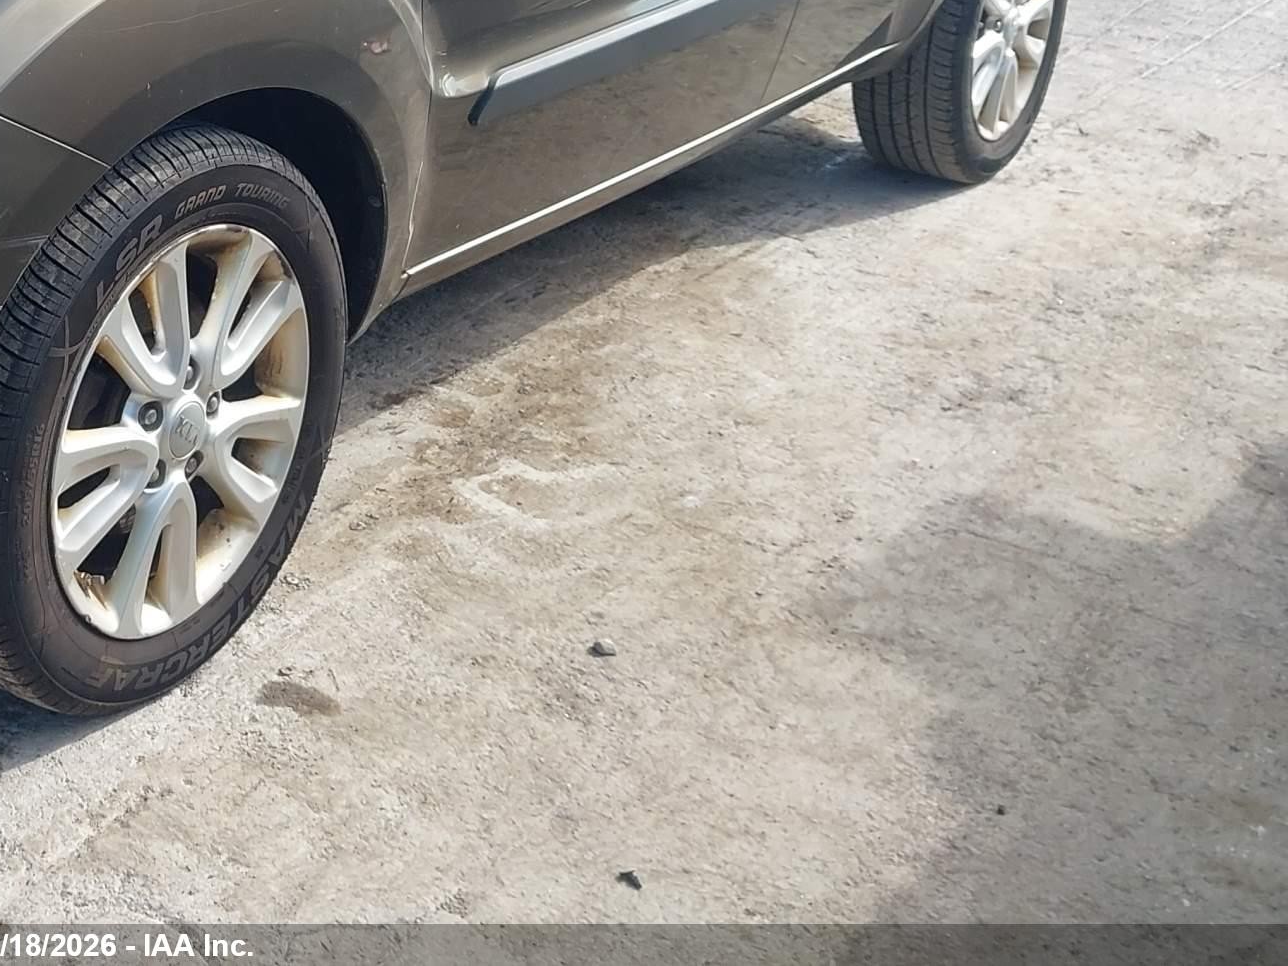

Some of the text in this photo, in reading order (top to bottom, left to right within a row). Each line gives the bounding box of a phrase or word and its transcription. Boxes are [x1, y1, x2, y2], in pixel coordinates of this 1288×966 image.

[96, 183, 291, 312] LSR GRAND TOURING
[62, 489, 310, 692] MASTERCRAF
